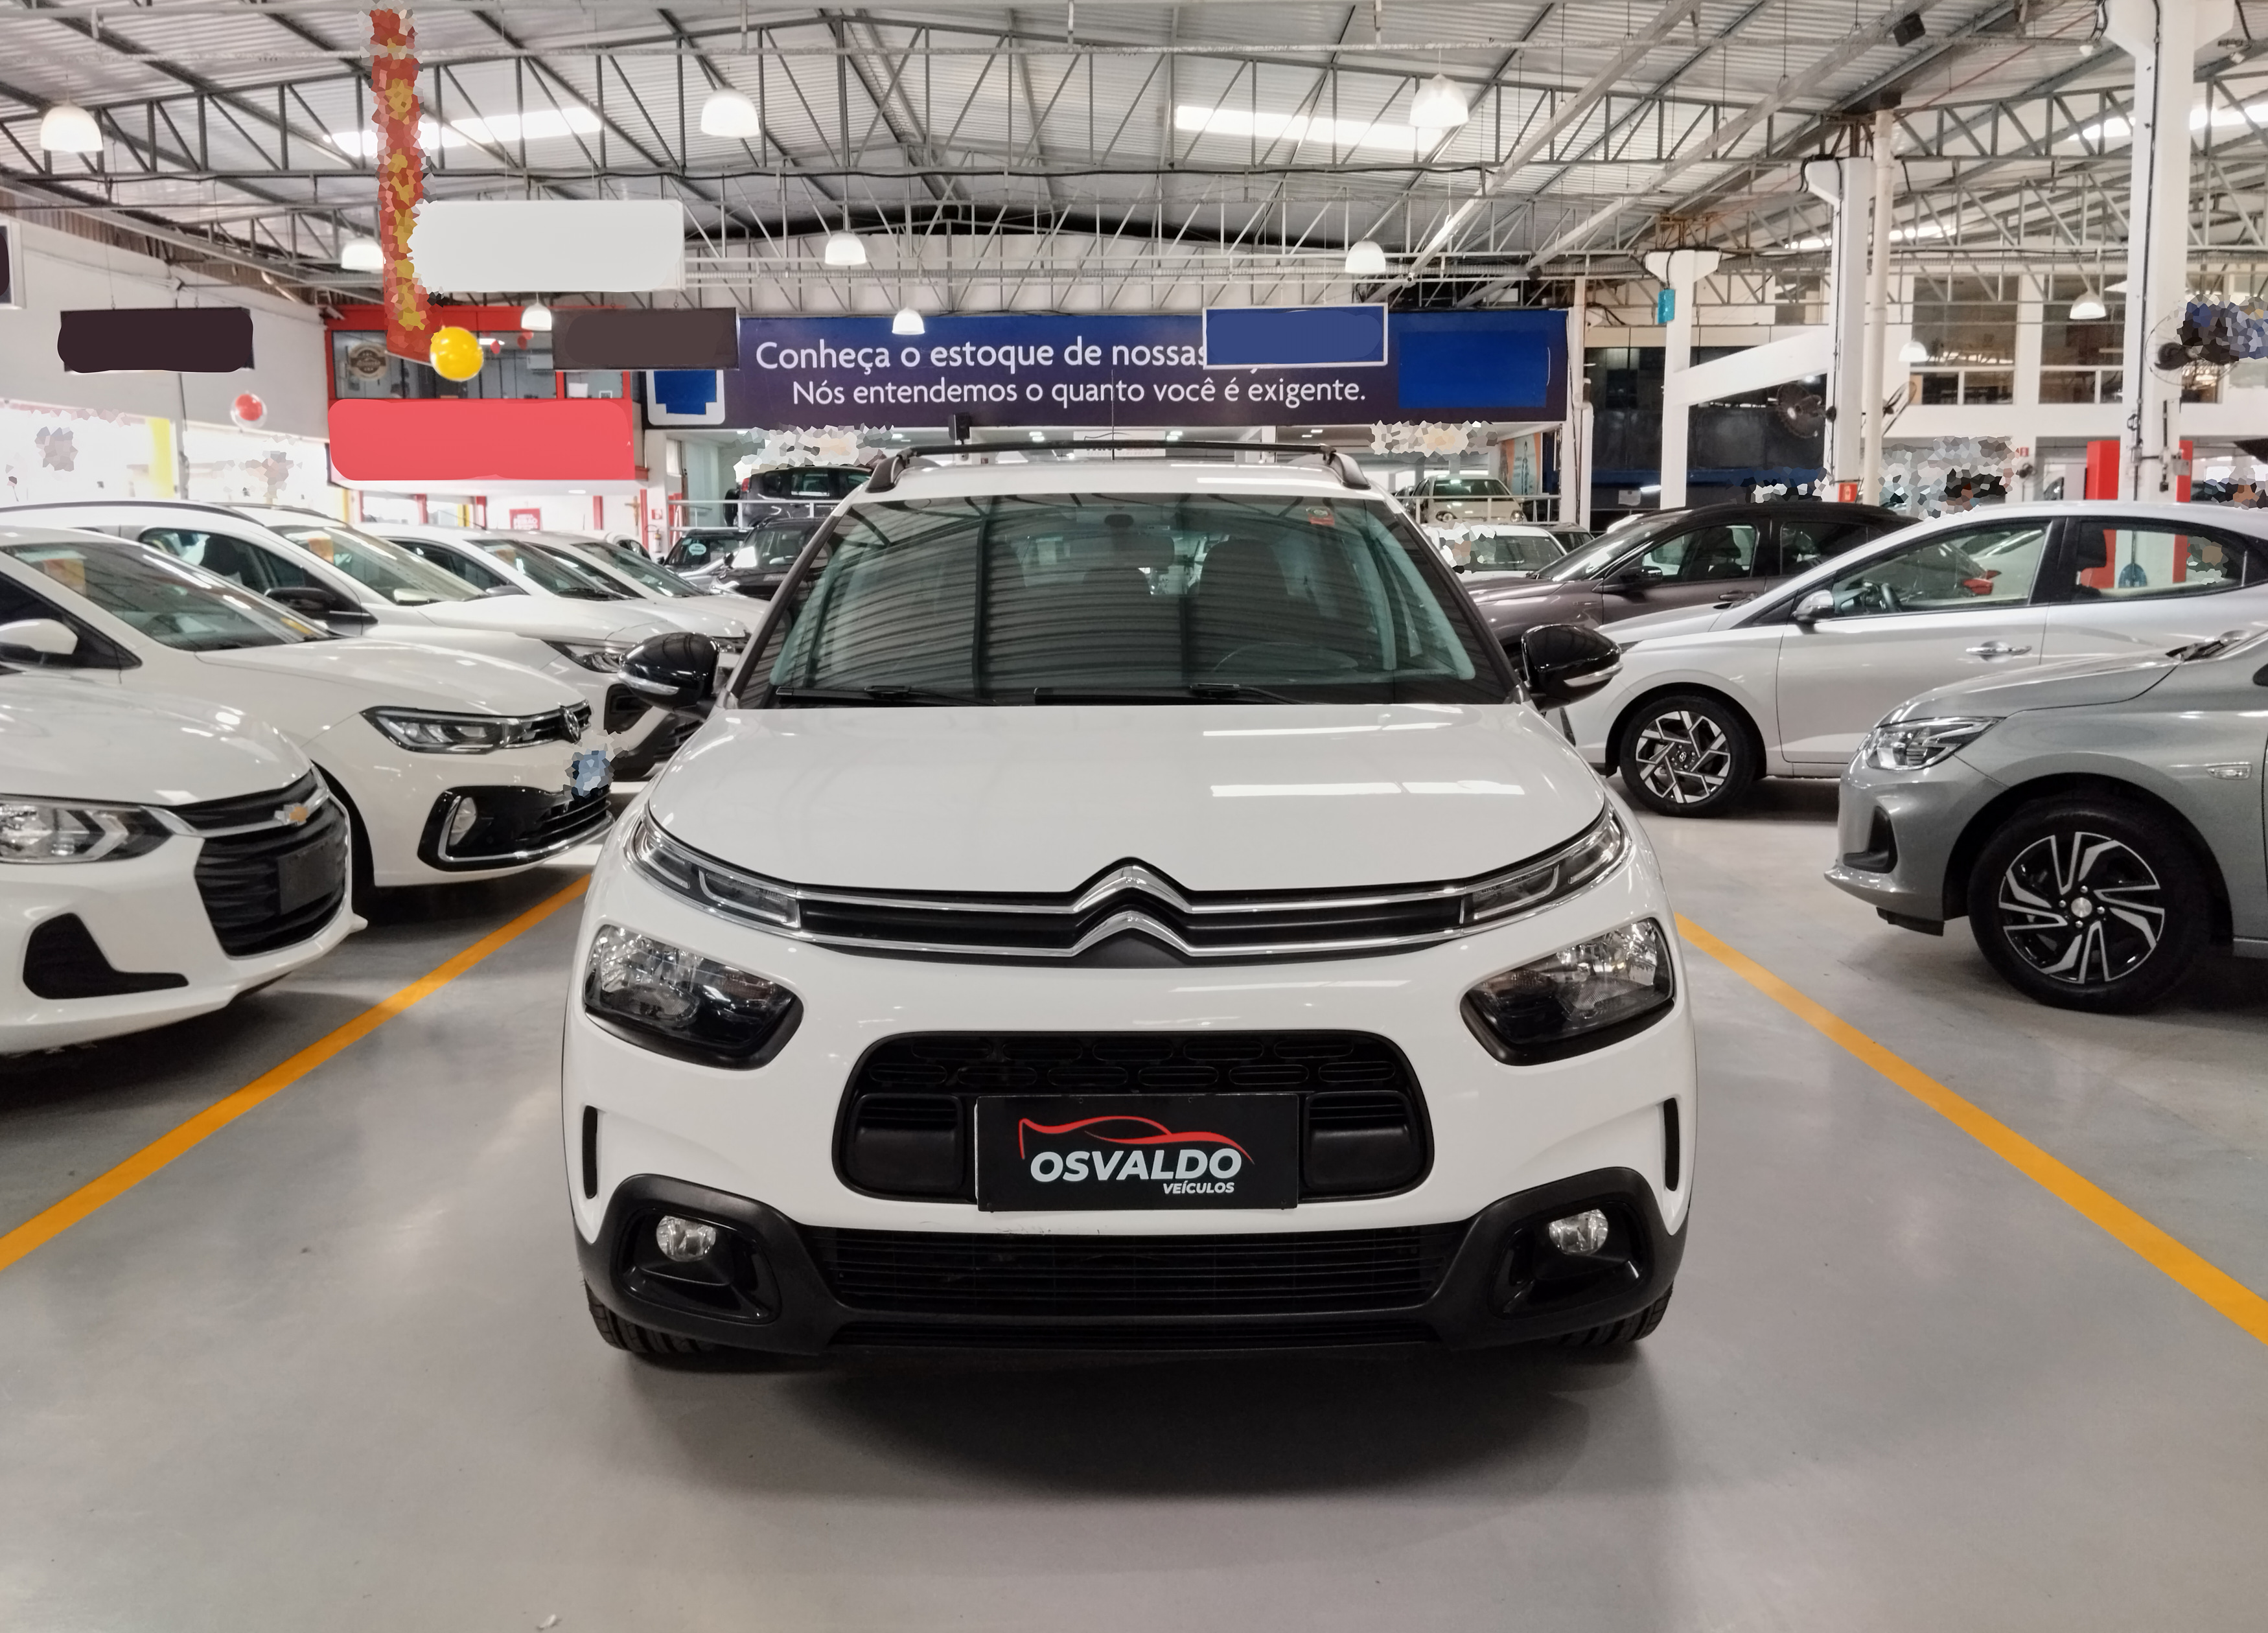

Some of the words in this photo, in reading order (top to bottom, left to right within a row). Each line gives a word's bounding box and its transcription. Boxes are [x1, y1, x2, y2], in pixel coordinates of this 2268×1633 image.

[756, 338, 890, 374] Conheça
[901, 347, 920, 367] o
[931, 342, 1054, 374] estoque
[1063, 336, 1102, 365] de
[794, 380, 844, 404] Nós
[853, 377, 1017, 404] entendemos
[1026, 384, 1043, 401] o
[1052, 380, 1144, 408] quanto
[1153, 377, 1215, 401] você
[1225, 377, 1239, 401] é
[1248, 378, 1365, 408] exigente.
[1030, 1148, 1242, 1182] OSVALDO
[1163, 1181, 1235, 1194] VEÍCULOS
